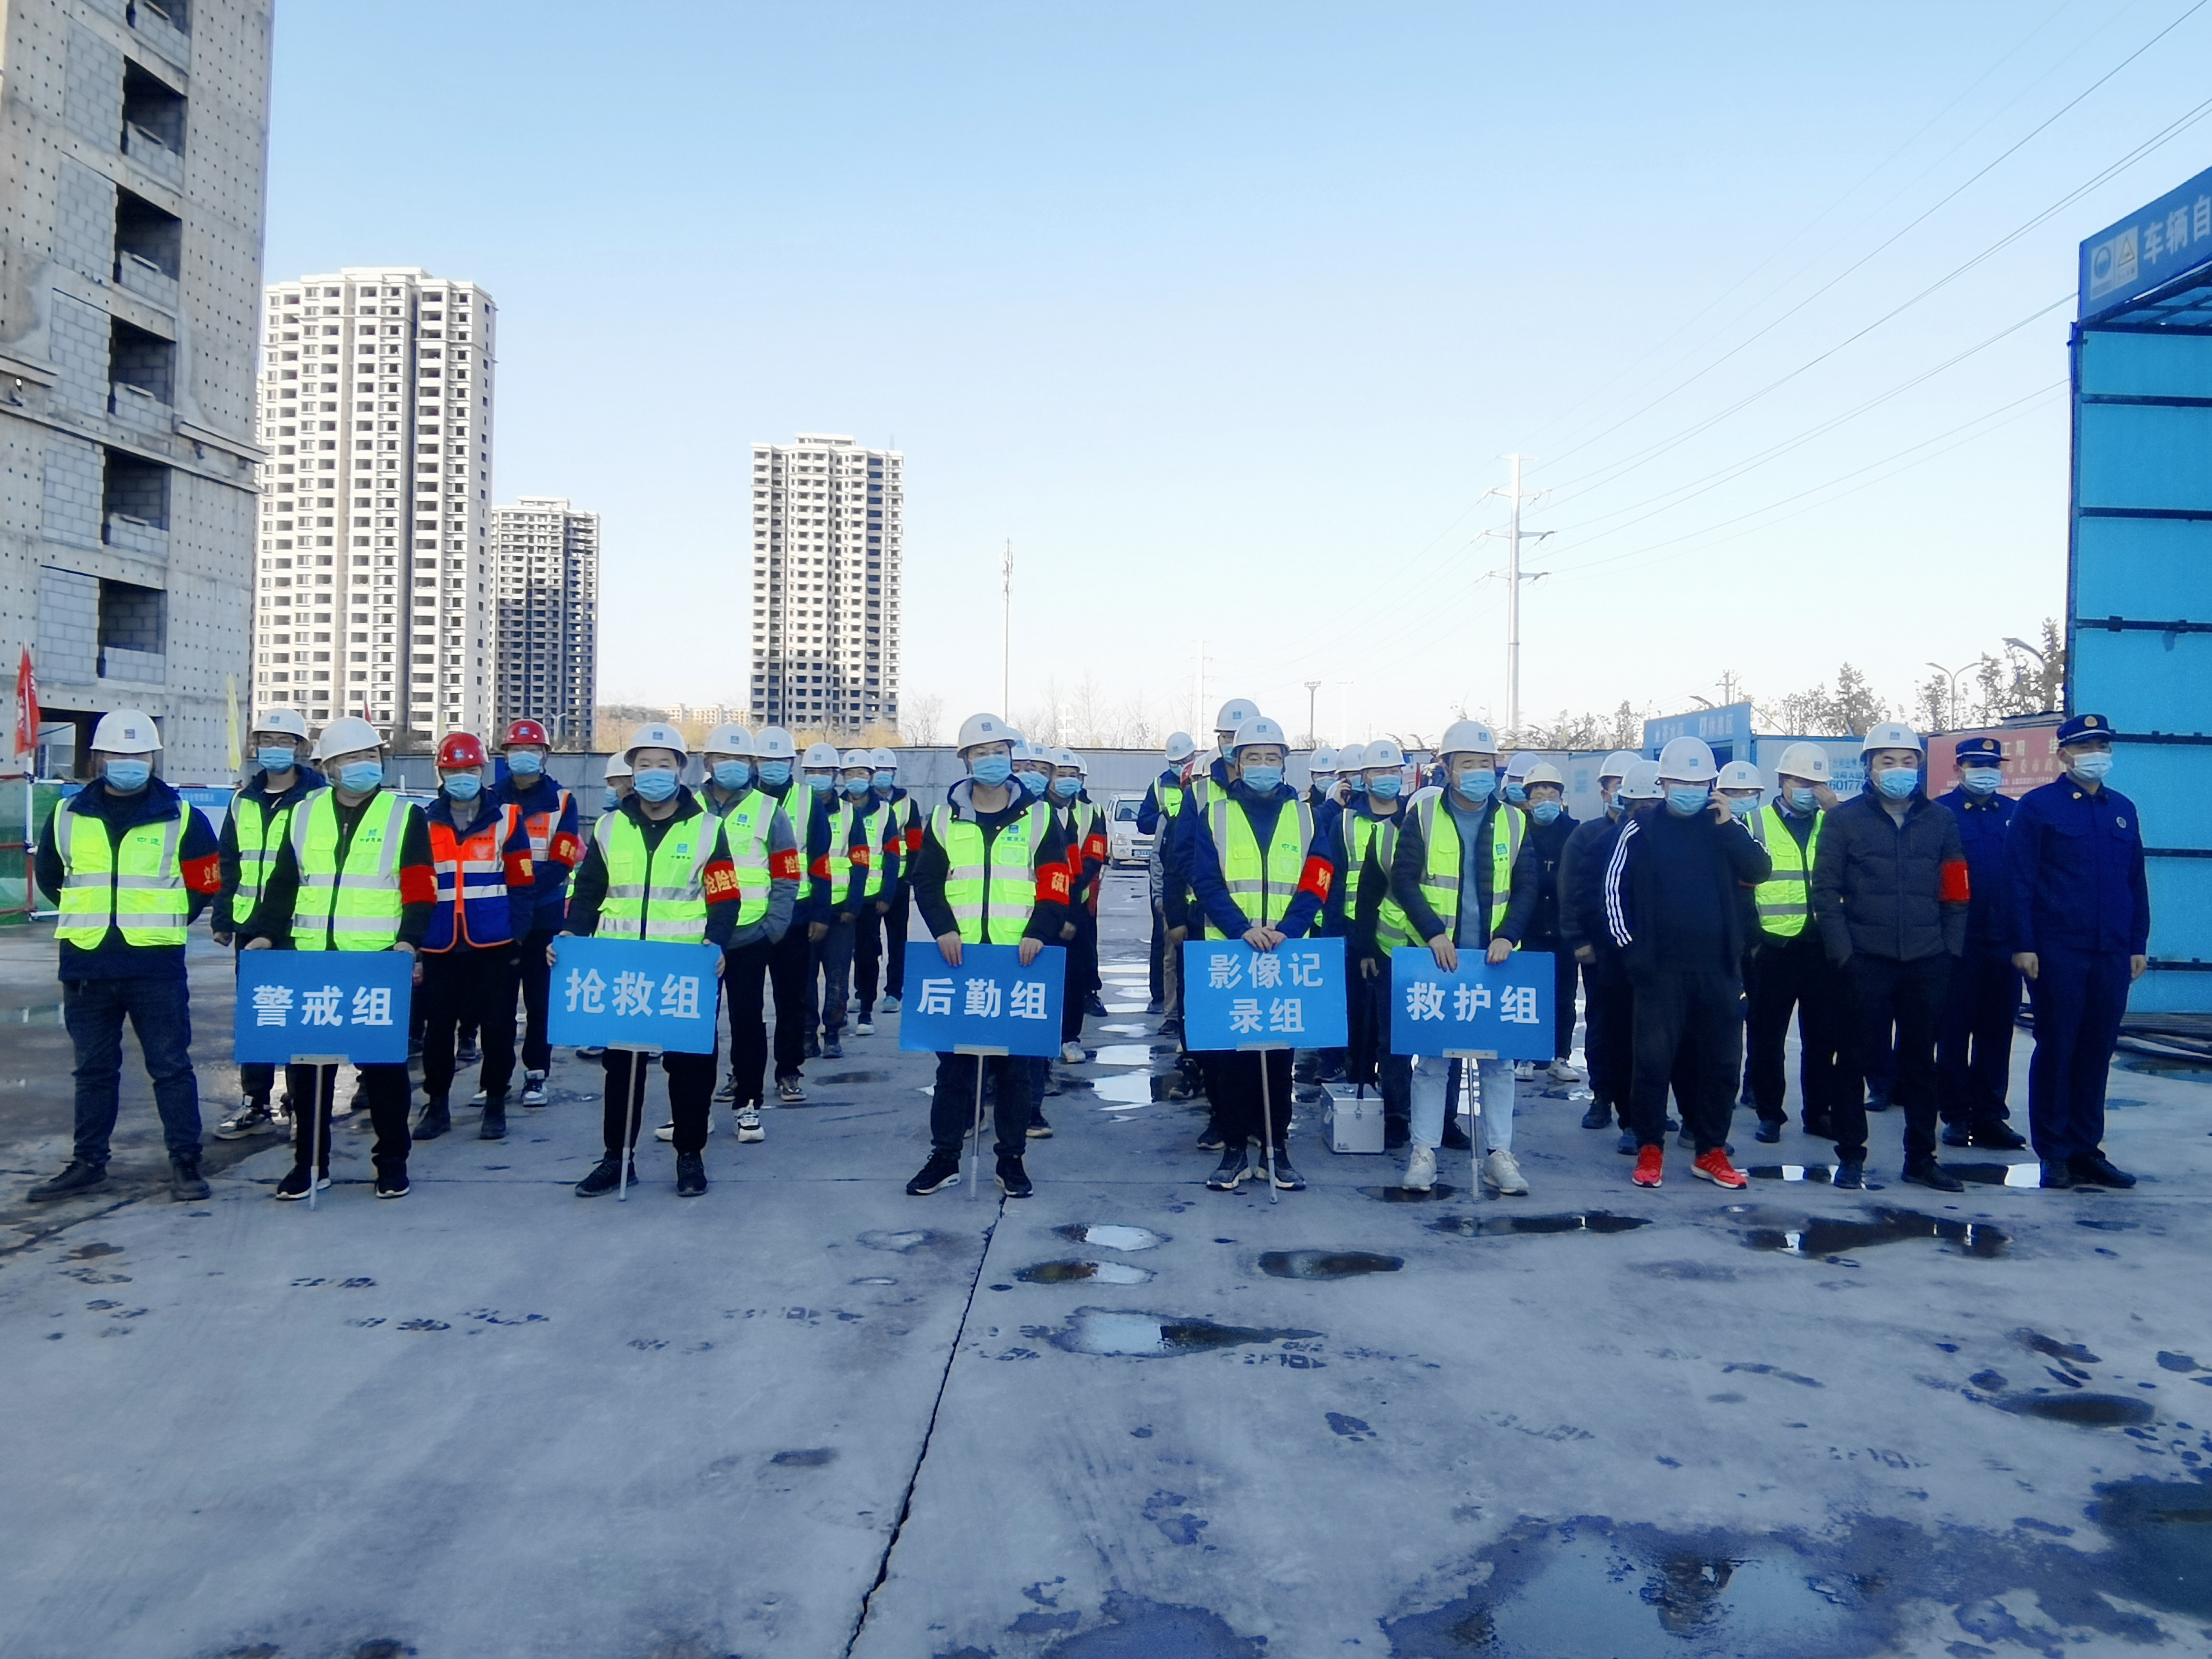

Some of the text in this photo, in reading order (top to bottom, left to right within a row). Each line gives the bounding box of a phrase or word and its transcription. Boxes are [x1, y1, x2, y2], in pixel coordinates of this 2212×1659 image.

[2143, 194, 2211, 265] 车辆自
[1051, 872, 1069, 896] 疏
[1208, 951, 1324, 990] 影像记
[252, 985, 393, 1027] 警戒组
[565, 968, 701, 1019] 抢救组
[917, 978, 1047, 1020] 后勤组
[1406, 981, 1540, 1024] 救护组
[1229, 997, 1305, 1034] 录组
